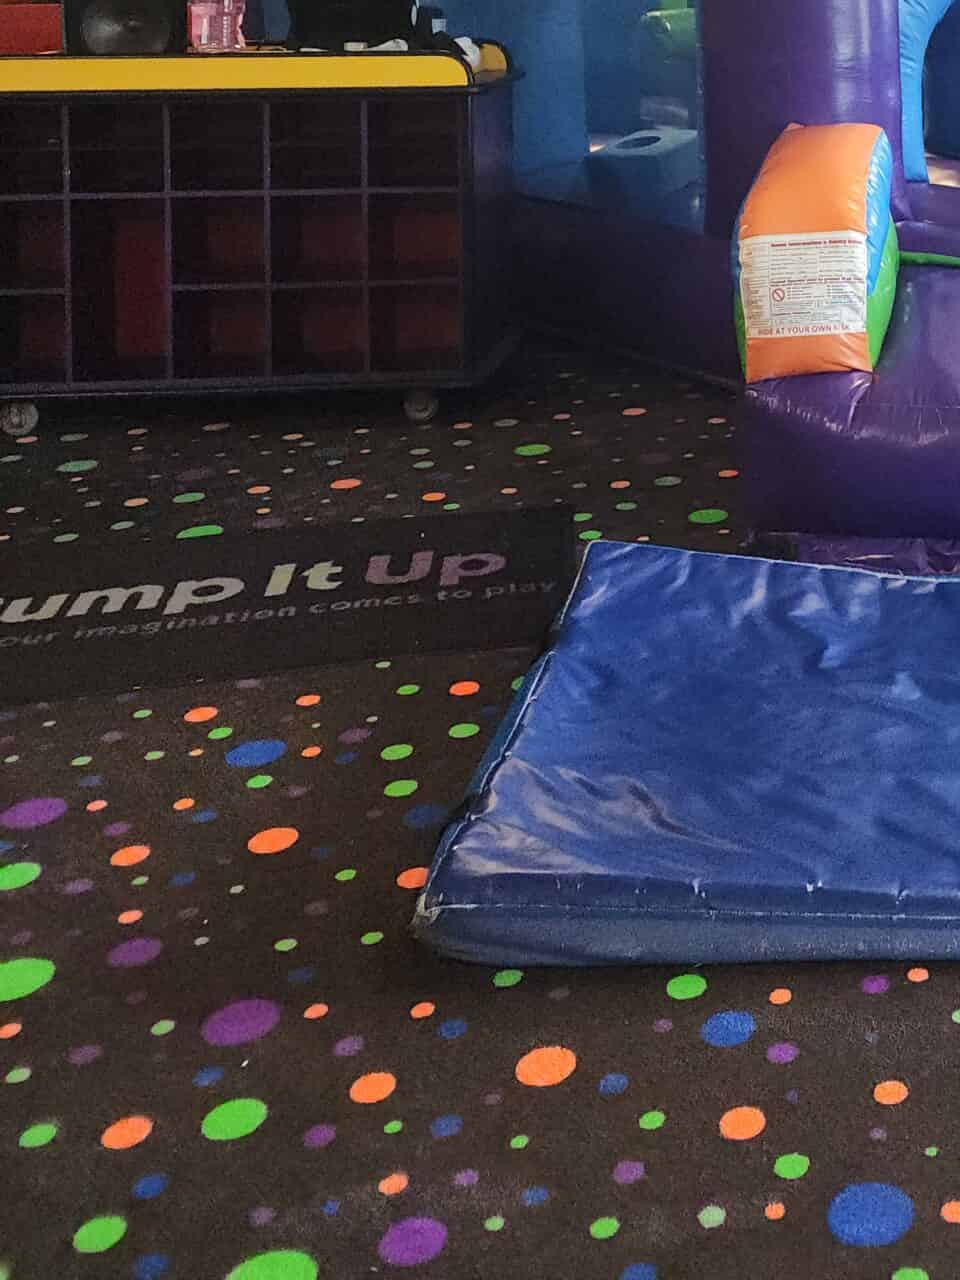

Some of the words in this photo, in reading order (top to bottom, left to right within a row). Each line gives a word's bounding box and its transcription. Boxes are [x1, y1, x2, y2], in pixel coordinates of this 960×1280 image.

[775, 327, 785, 335] AT
[787, 326, 809, 334] YOUR
[810, 324, 831, 333] OWN
[0, 577, 245, 624] ump
[263, 560, 344, 597] It
[364, 551, 507, 587] Up
[73, 606, 297, 640] imagination
[308, 592, 424, 614] comes
[437, 588, 473, 602] to
[482, 580, 557, 599] play
